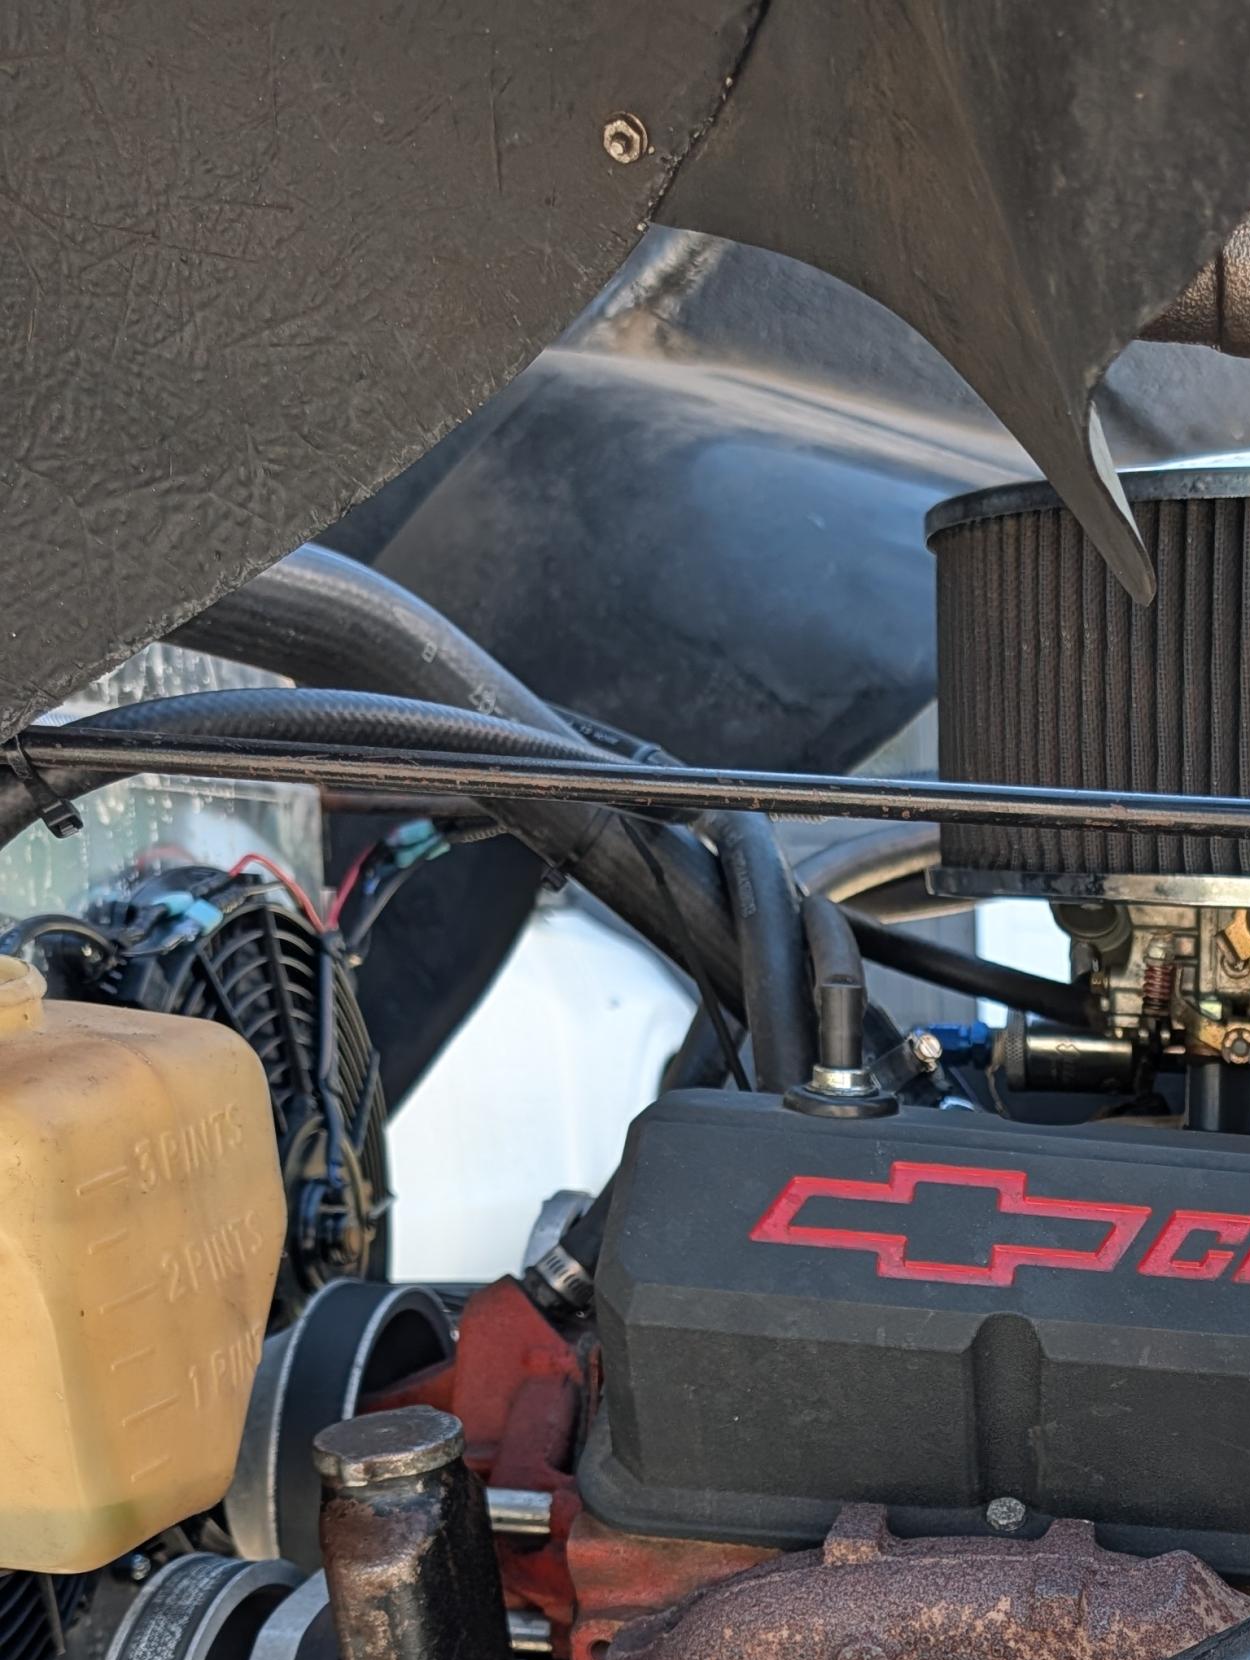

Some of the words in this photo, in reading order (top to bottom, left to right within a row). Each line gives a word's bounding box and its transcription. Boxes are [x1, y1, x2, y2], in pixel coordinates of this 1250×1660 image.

[133, 1137, 156, 1192] 3
[159, 1102, 244, 1180] PINTS
[161, 1251, 188, 1303] 2
[184, 1209, 263, 1291] PINTS
